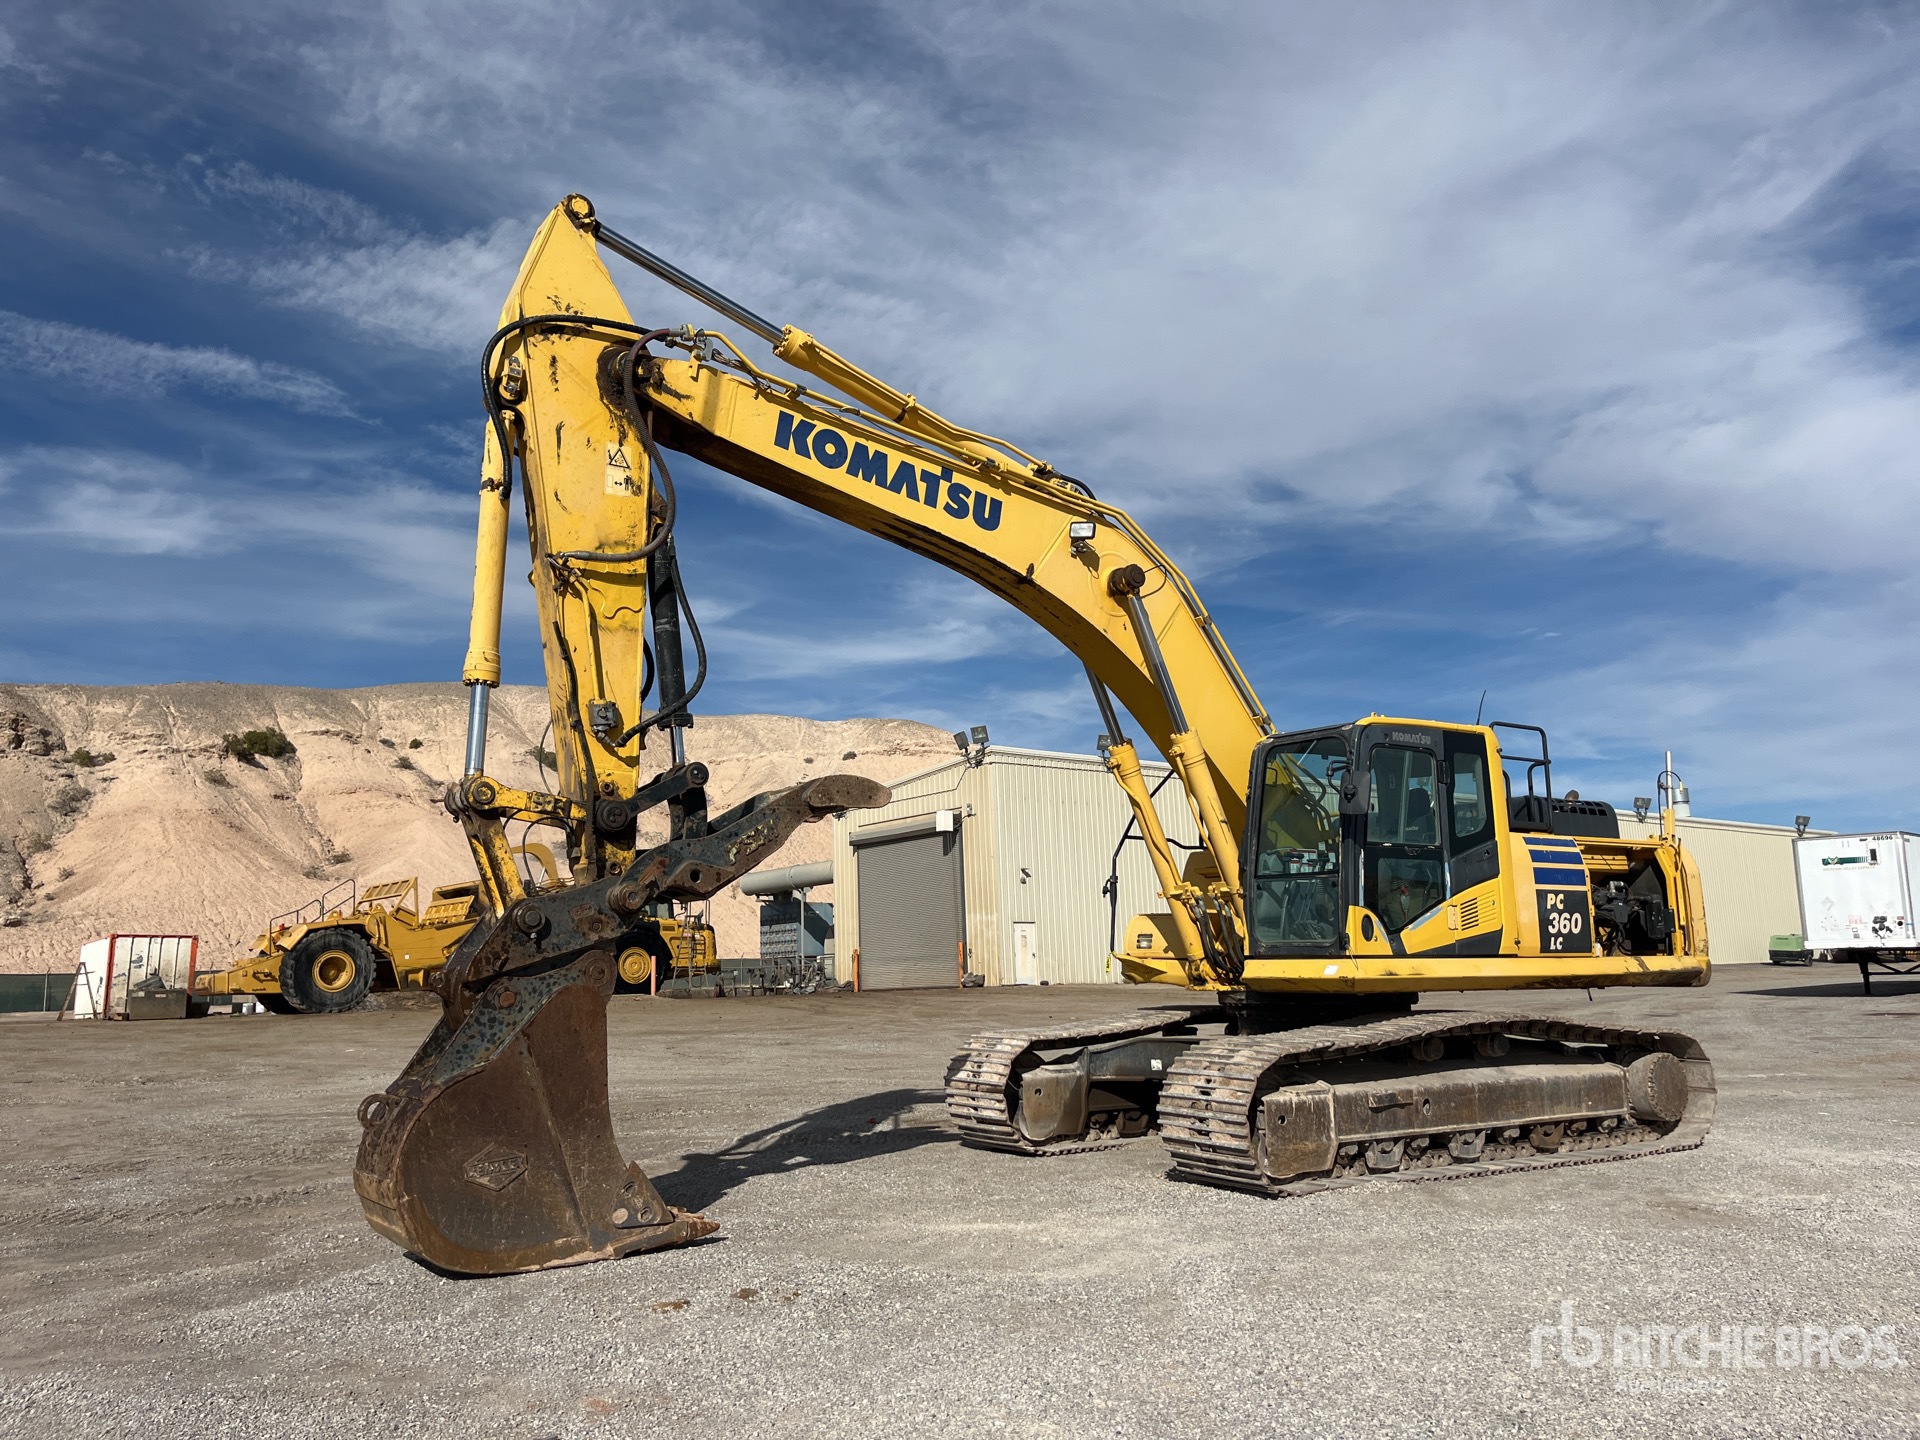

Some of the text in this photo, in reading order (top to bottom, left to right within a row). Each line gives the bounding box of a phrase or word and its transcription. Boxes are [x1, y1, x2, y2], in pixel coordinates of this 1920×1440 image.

[774, 410, 1003, 531] KOMATSU
[1392, 732, 1431, 745] KOMATSU
[1547, 893, 1564, 909] PC
[1548, 912, 1582, 934] 360
[1550, 937, 1563, 950] LC
